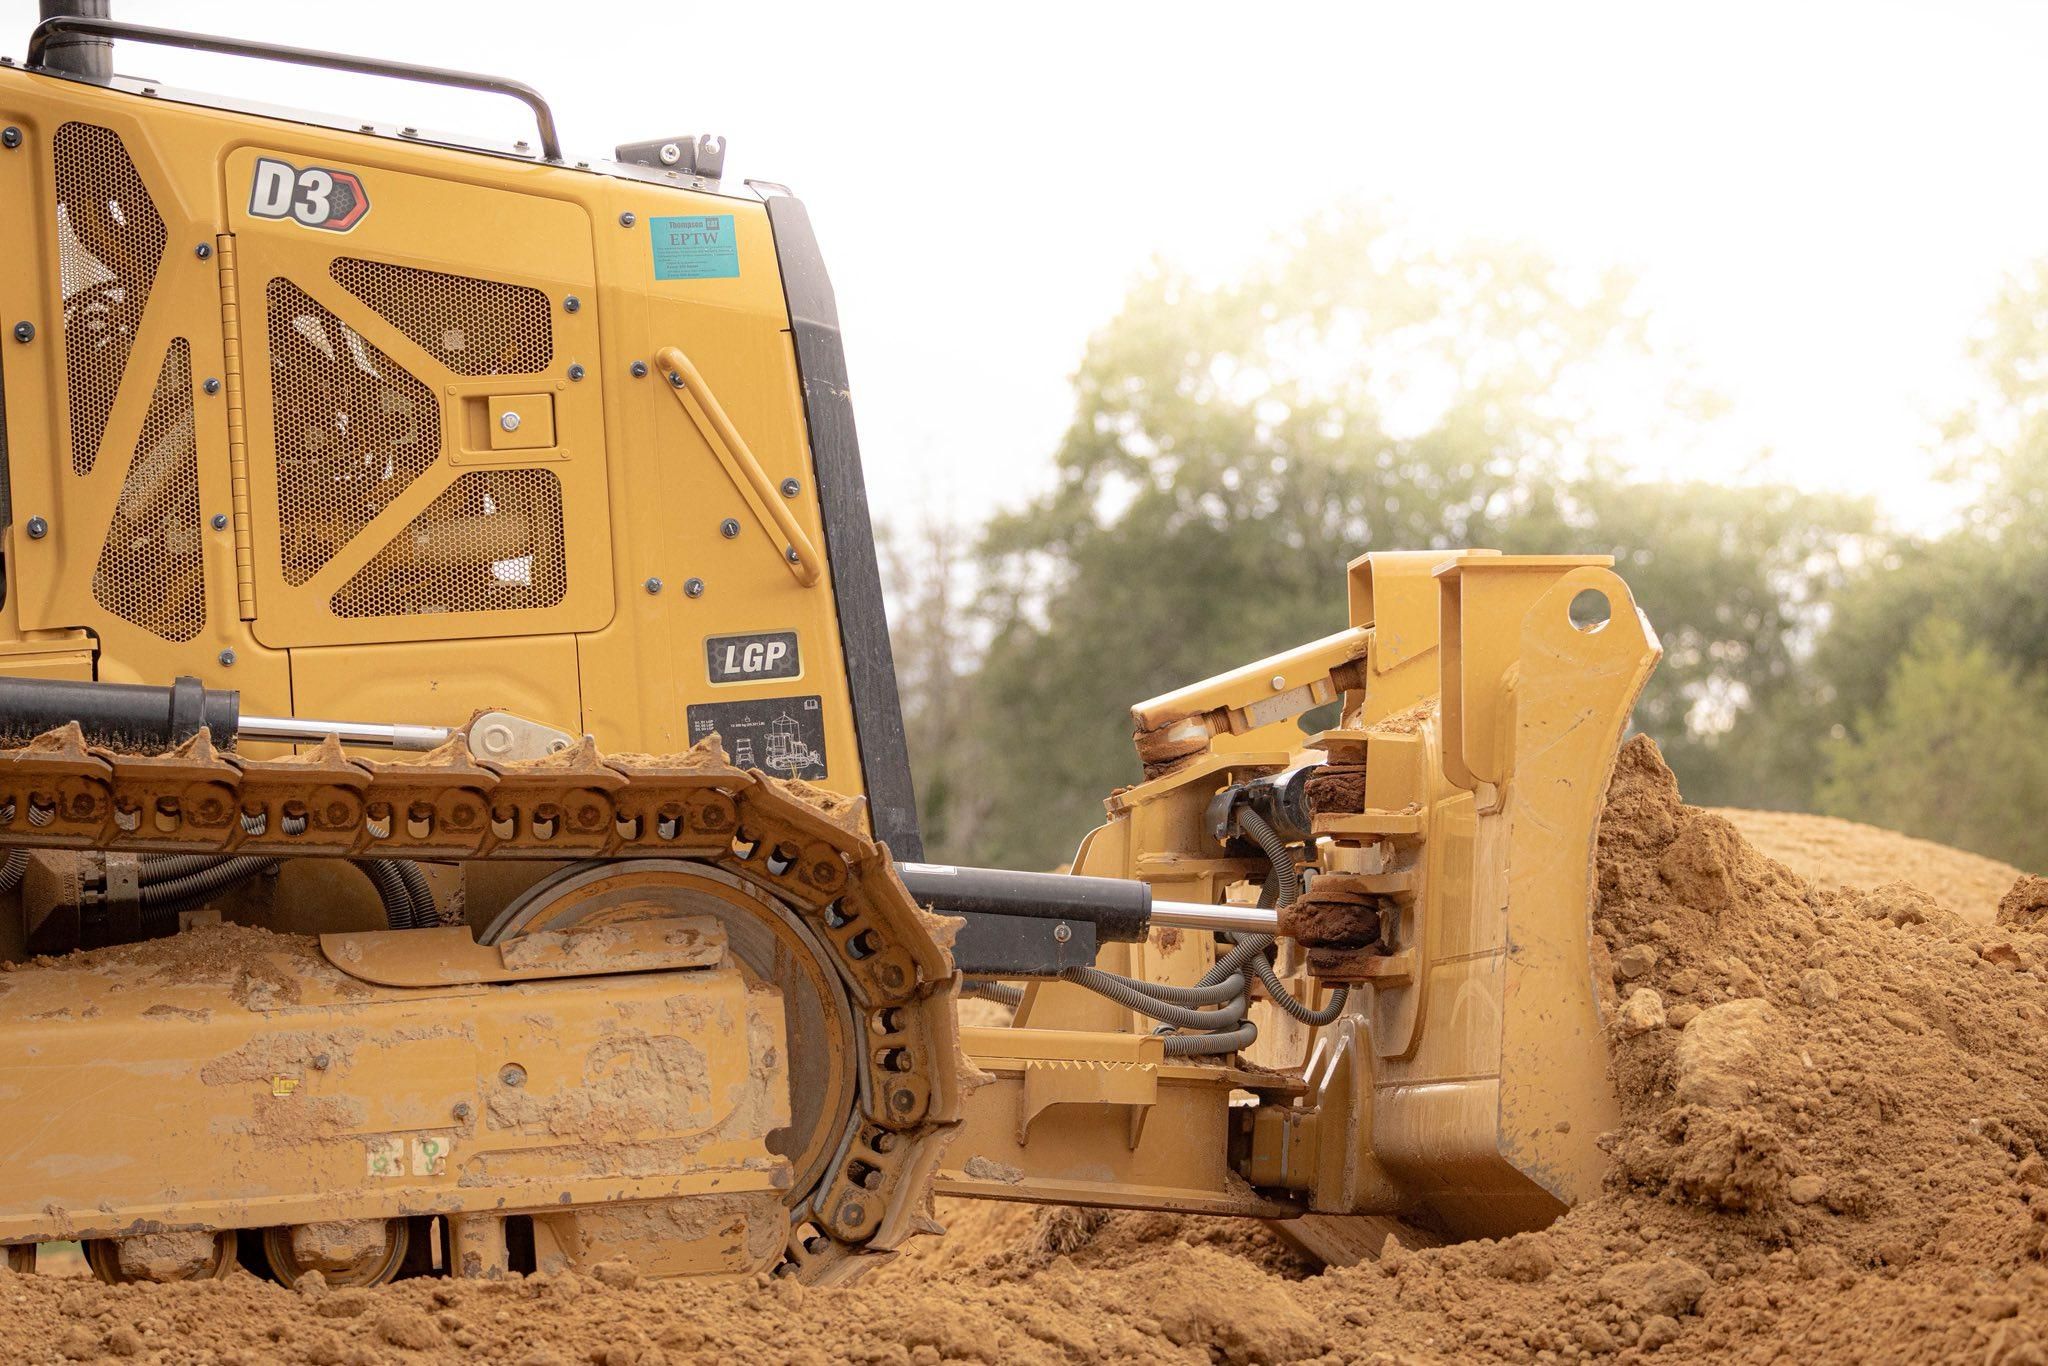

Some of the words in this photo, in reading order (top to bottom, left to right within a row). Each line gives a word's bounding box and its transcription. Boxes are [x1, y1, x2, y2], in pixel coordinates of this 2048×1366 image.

[252, 160, 333, 224] D3
[670, 221, 704, 229] Thompson
[670, 232, 718, 245] EPTW
[723, 641, 787, 674] LGP
